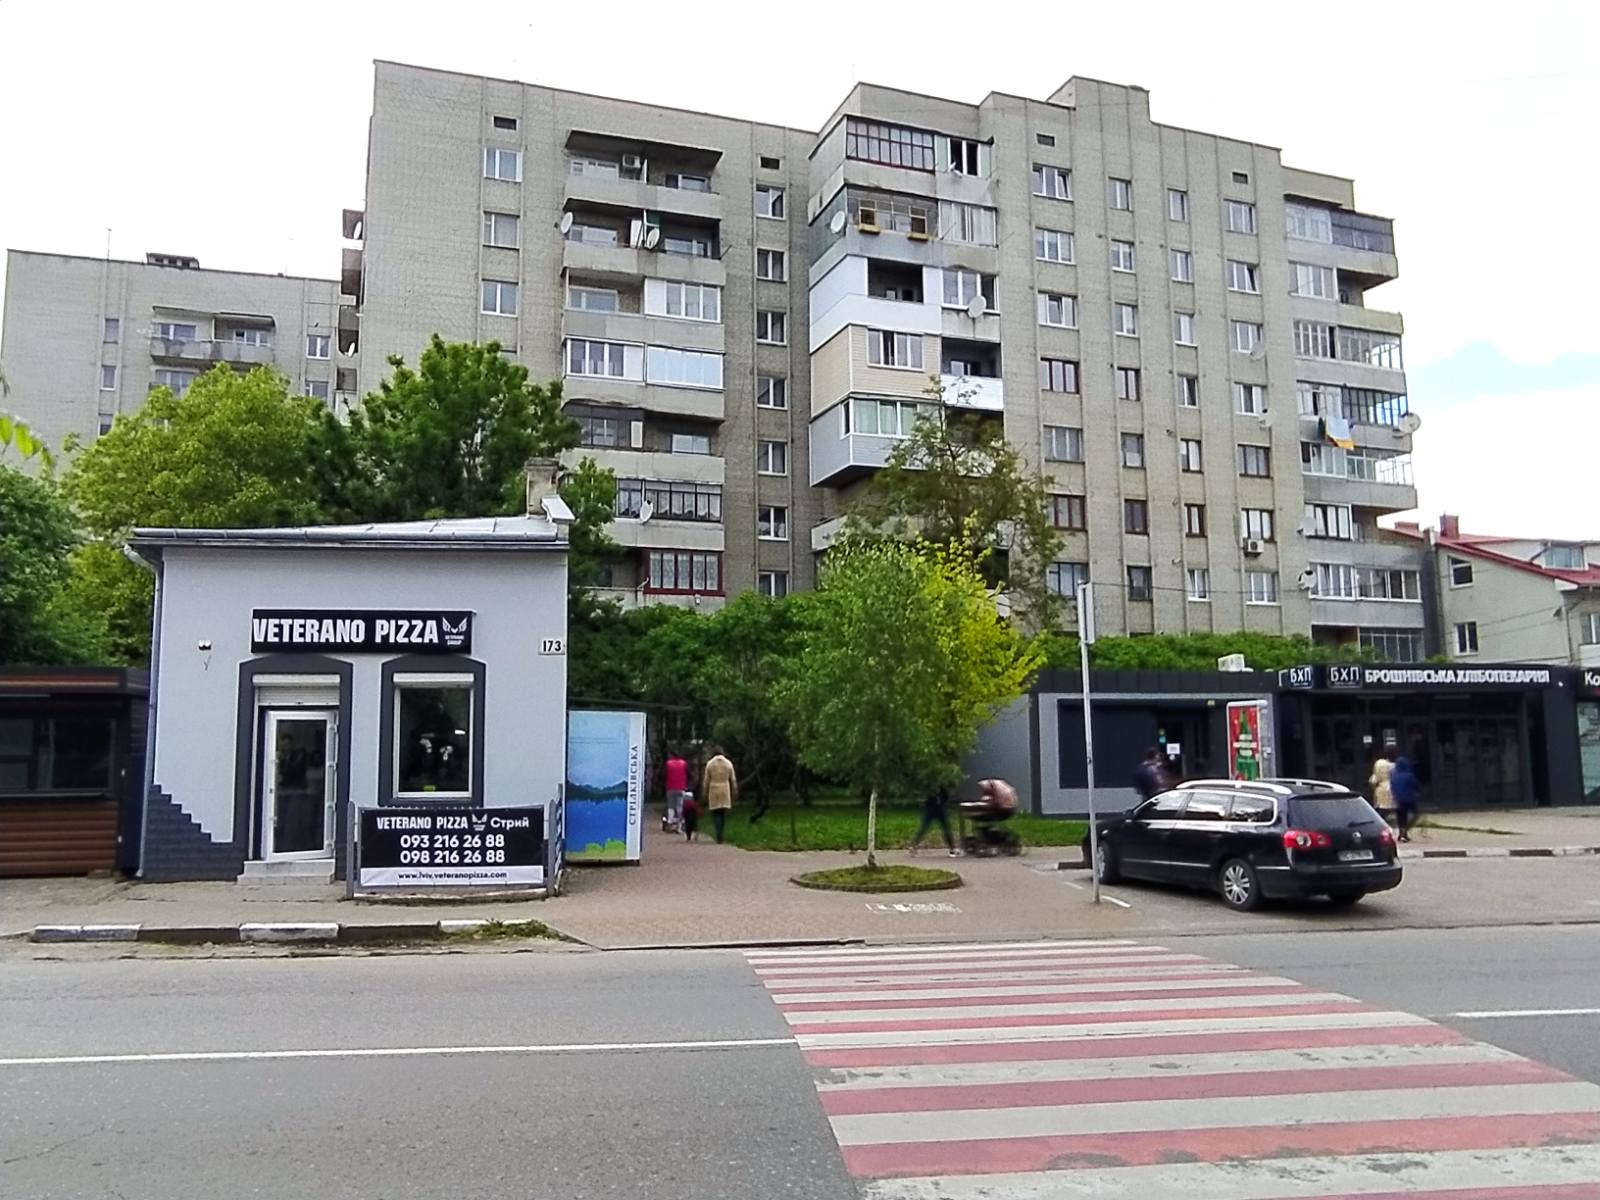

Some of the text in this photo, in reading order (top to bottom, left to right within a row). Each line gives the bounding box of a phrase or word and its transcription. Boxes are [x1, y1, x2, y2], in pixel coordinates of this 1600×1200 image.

[253, 618, 366, 643] VETERANO
[375, 619, 439, 643] PIZZA
[543, 640, 562, 652] 173
[1290, 667, 1312, 683] БХП
[1330, 666, 1360, 681] БХП
[628, 745, 638, 825] СТРІЛКІВСЬКА
[376, 816, 432, 830] VETERANO
[436, 816, 469, 829] PIZZA
[490, 816, 530, 830] Стрий
[400, 834, 505, 848] 093 216 26 88
[400, 849, 506, 864] 098 216 26 88
